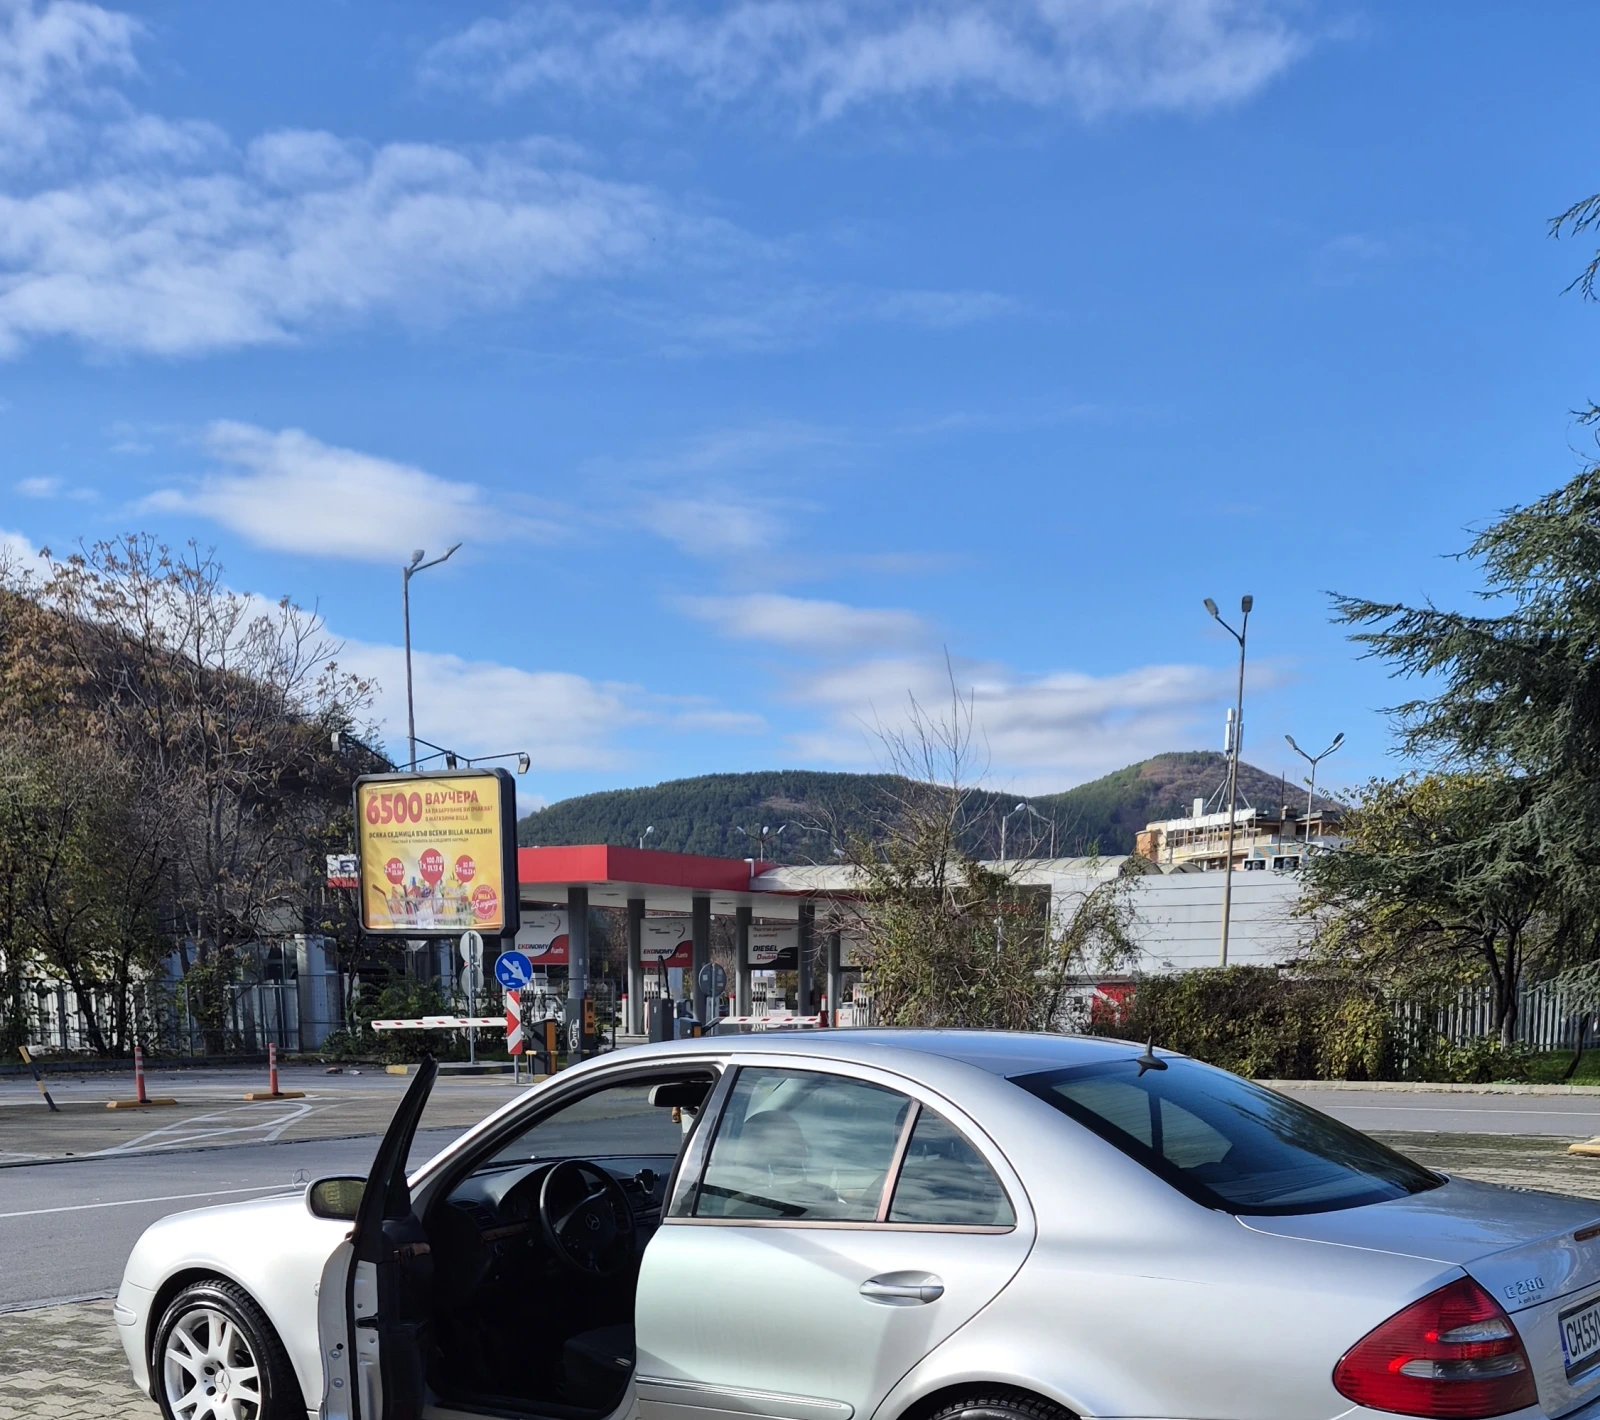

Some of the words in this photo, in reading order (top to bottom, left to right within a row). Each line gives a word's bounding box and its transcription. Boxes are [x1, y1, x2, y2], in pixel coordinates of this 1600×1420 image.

[366, 791, 423, 825] 6500
[425, 790, 479, 805] ВАУЧЕРА
[428, 829, 448, 837] ВСЕКИ
[464, 828, 493, 836] МАГАЗИН
[752, 944, 779, 952] DIESEL
[1504, 1284, 1517, 1300] E
[1515, 1277, 1545, 1295] 280
